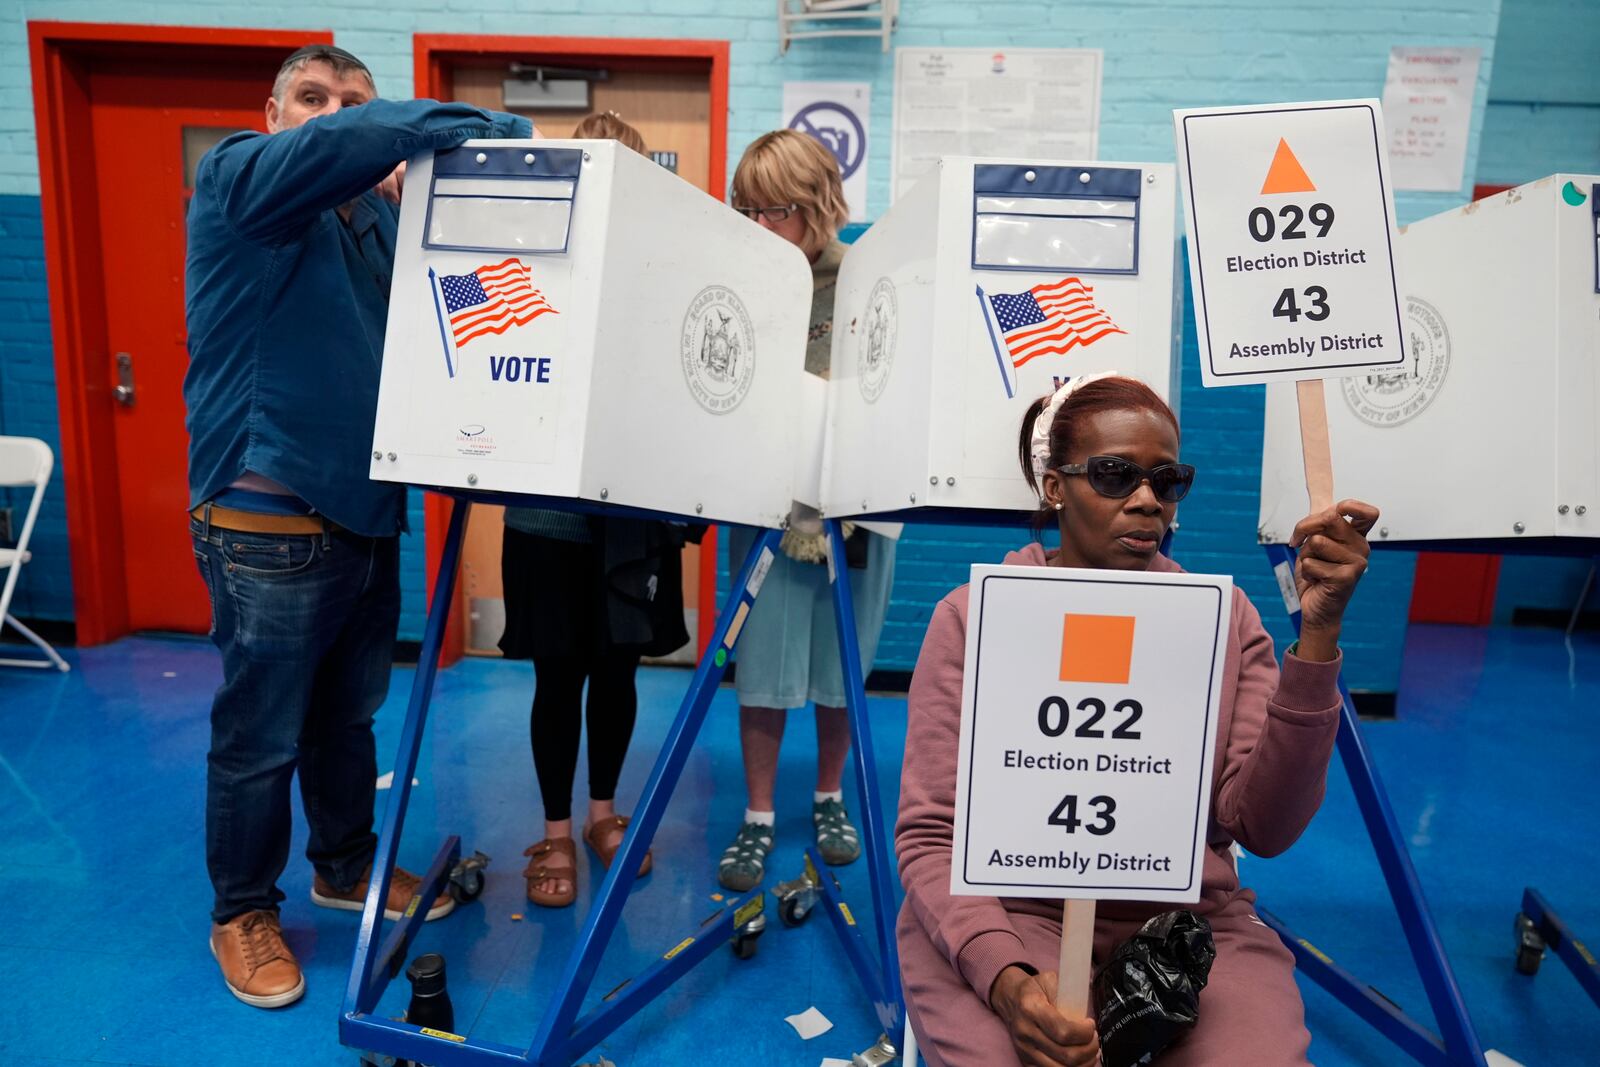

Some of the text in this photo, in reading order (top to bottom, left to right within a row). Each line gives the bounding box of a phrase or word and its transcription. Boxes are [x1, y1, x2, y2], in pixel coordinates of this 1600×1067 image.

[1249, 203, 1334, 242] 029
[1226, 249, 1366, 273] Election District
[1273, 285, 1331, 322] 43
[1229, 333, 1384, 359] Assembly District
[490, 356, 551, 383] VOTE
[1037, 696, 1143, 740] 022
[1004, 749, 1172, 775] Election District
[1047, 794, 1117, 836] 43
[987, 849, 1171, 875] Assembly District
